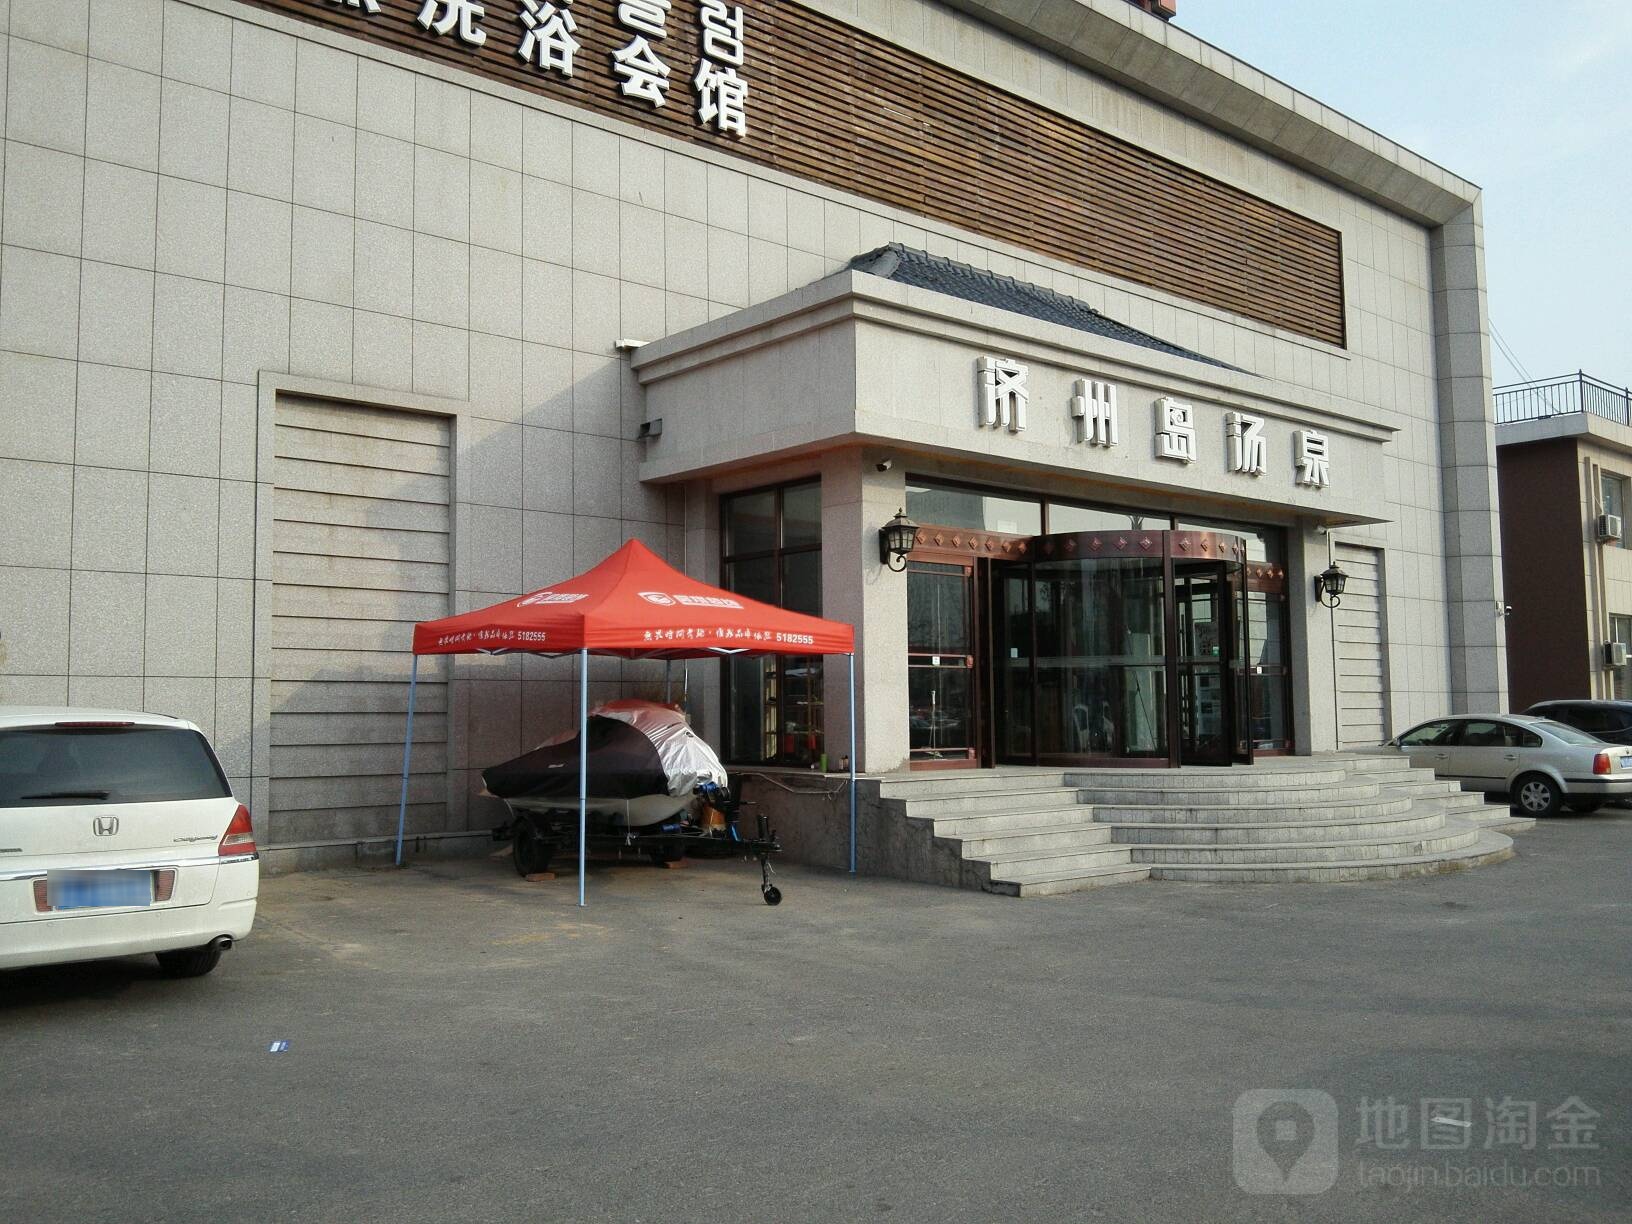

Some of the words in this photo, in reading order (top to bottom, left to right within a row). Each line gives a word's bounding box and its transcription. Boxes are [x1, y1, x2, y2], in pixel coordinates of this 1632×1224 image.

[329, 0, 749, 138] 洗浴会馆
[977, 355, 1330, 488] 济州岛汤泉
[517, 631, 546, 642] 5182555
[776, 631, 814, 645] 5182555
